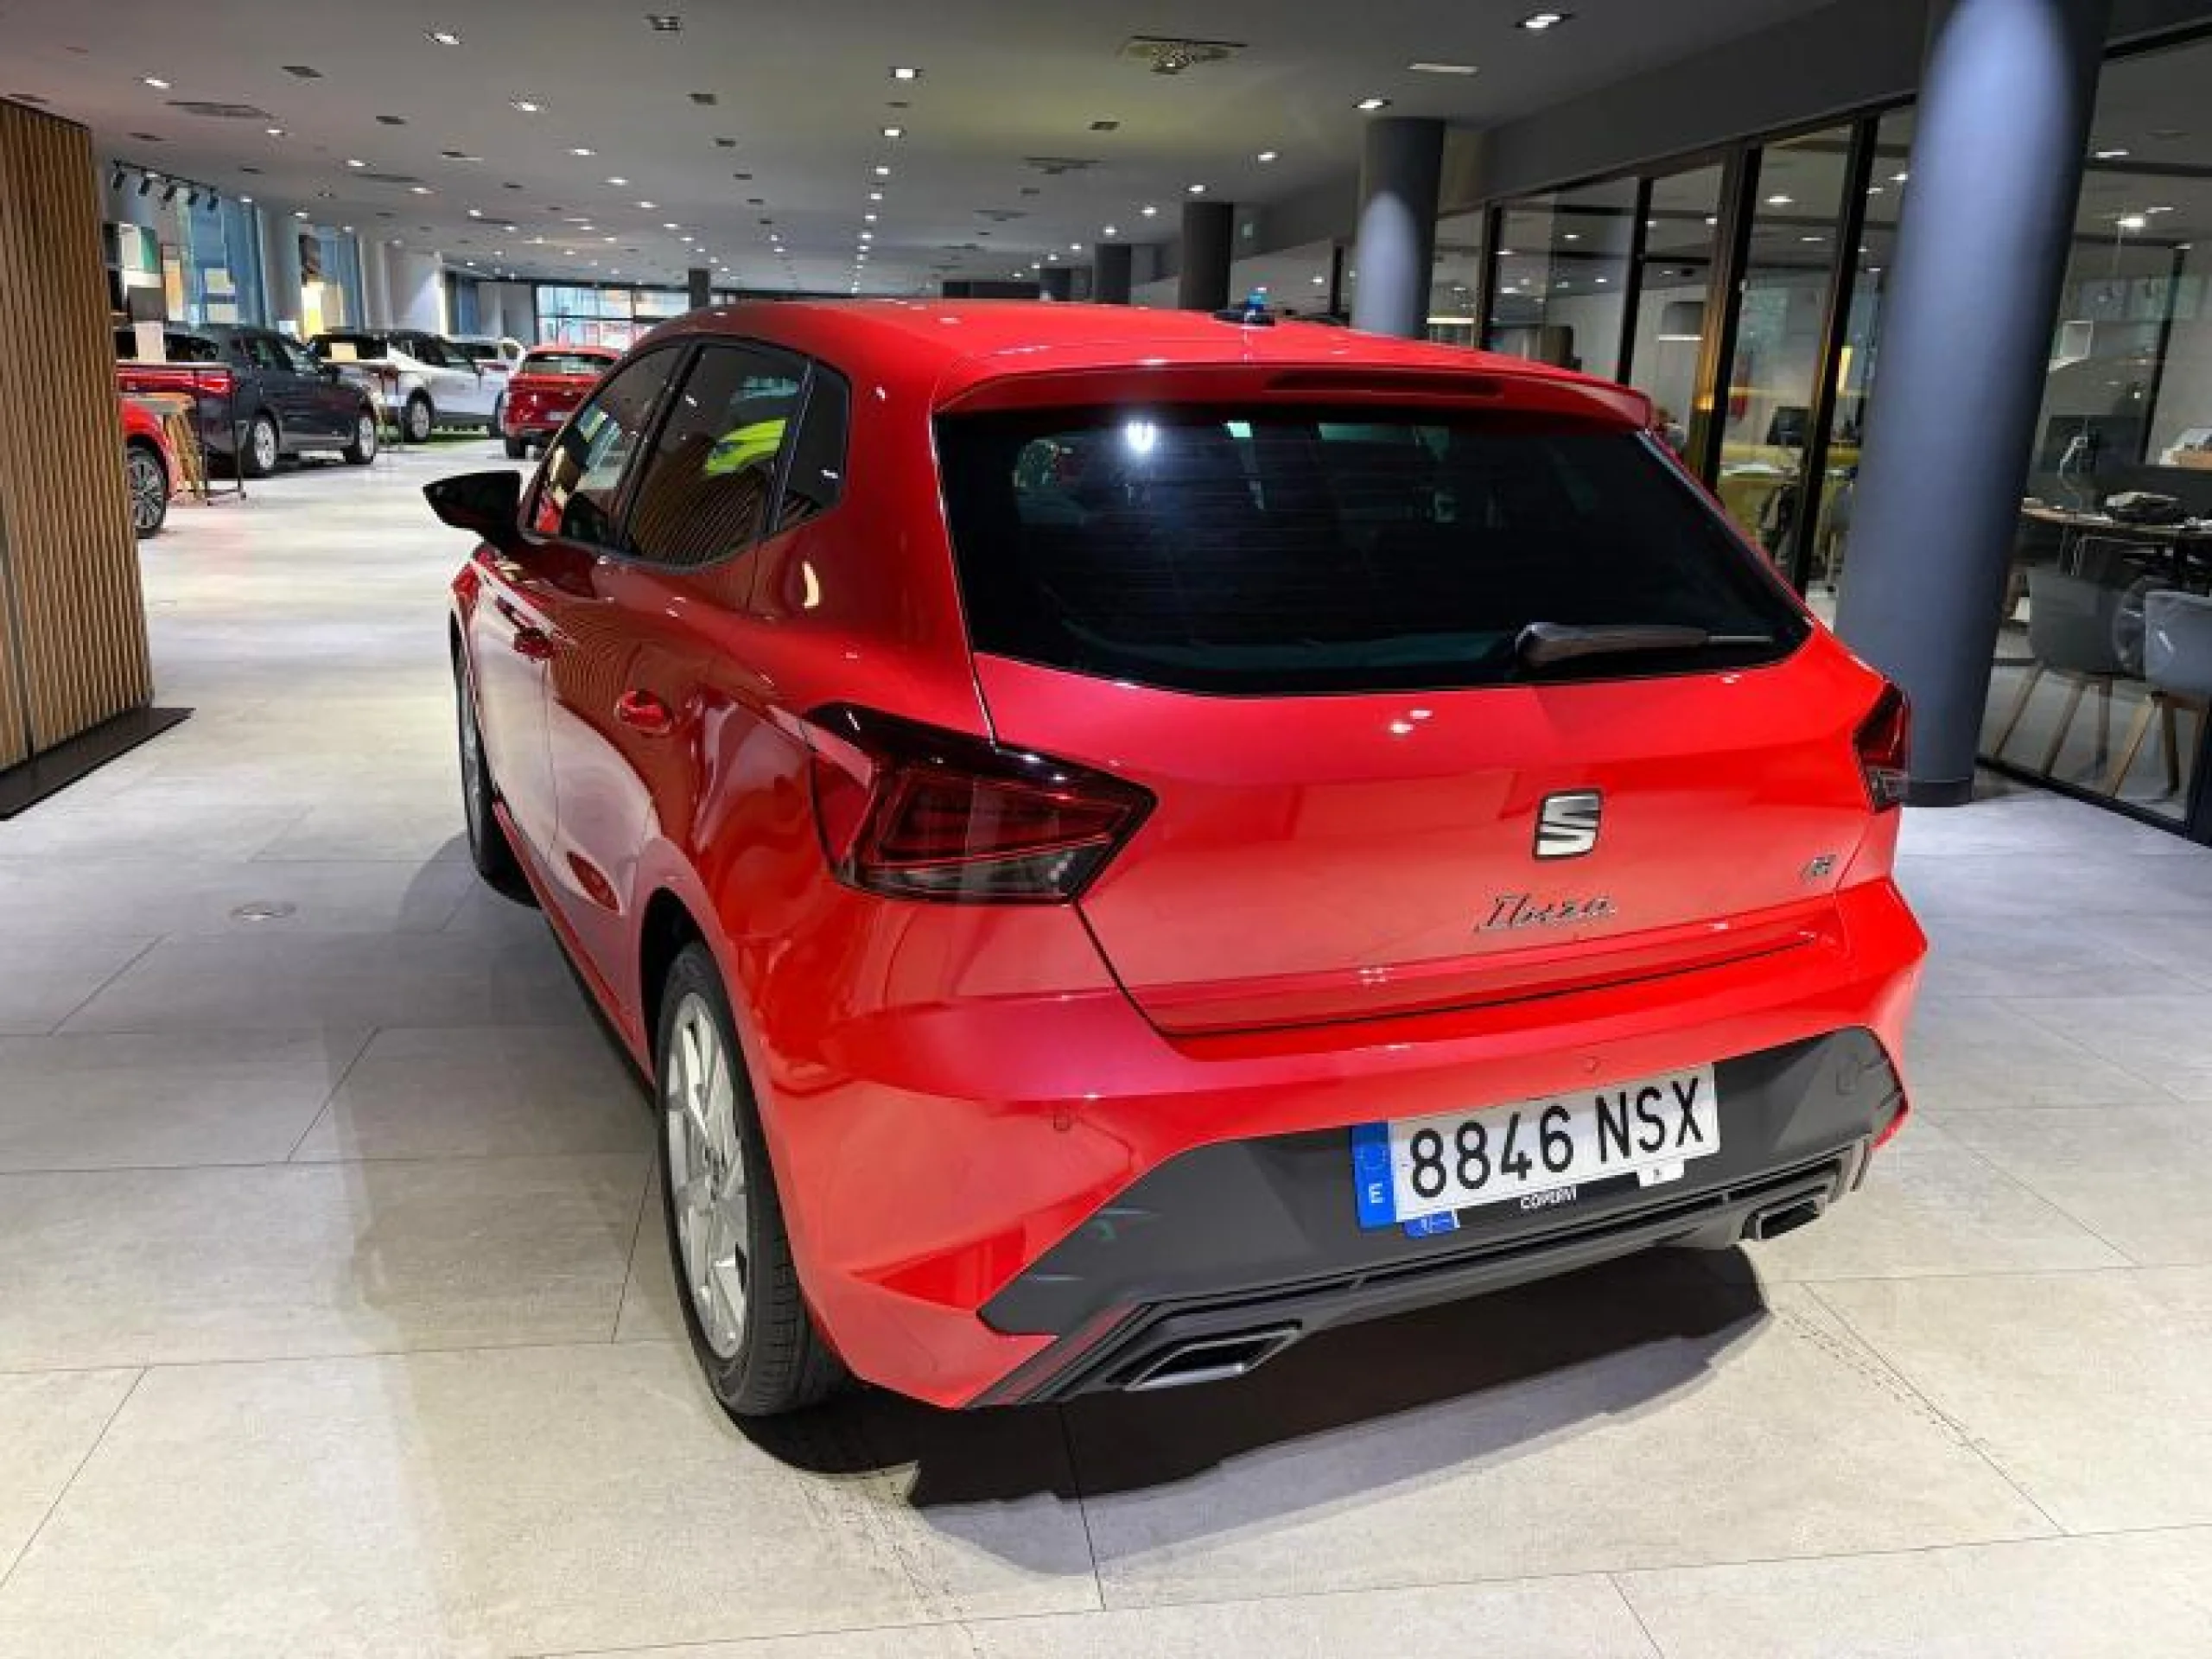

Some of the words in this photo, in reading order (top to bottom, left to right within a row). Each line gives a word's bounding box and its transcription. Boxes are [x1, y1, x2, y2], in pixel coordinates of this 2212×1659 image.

[1410, 1105, 1573, 1198] 8846
[1595, 1076, 1704, 1163] NSX
[1368, 1182, 1385, 1204] E
